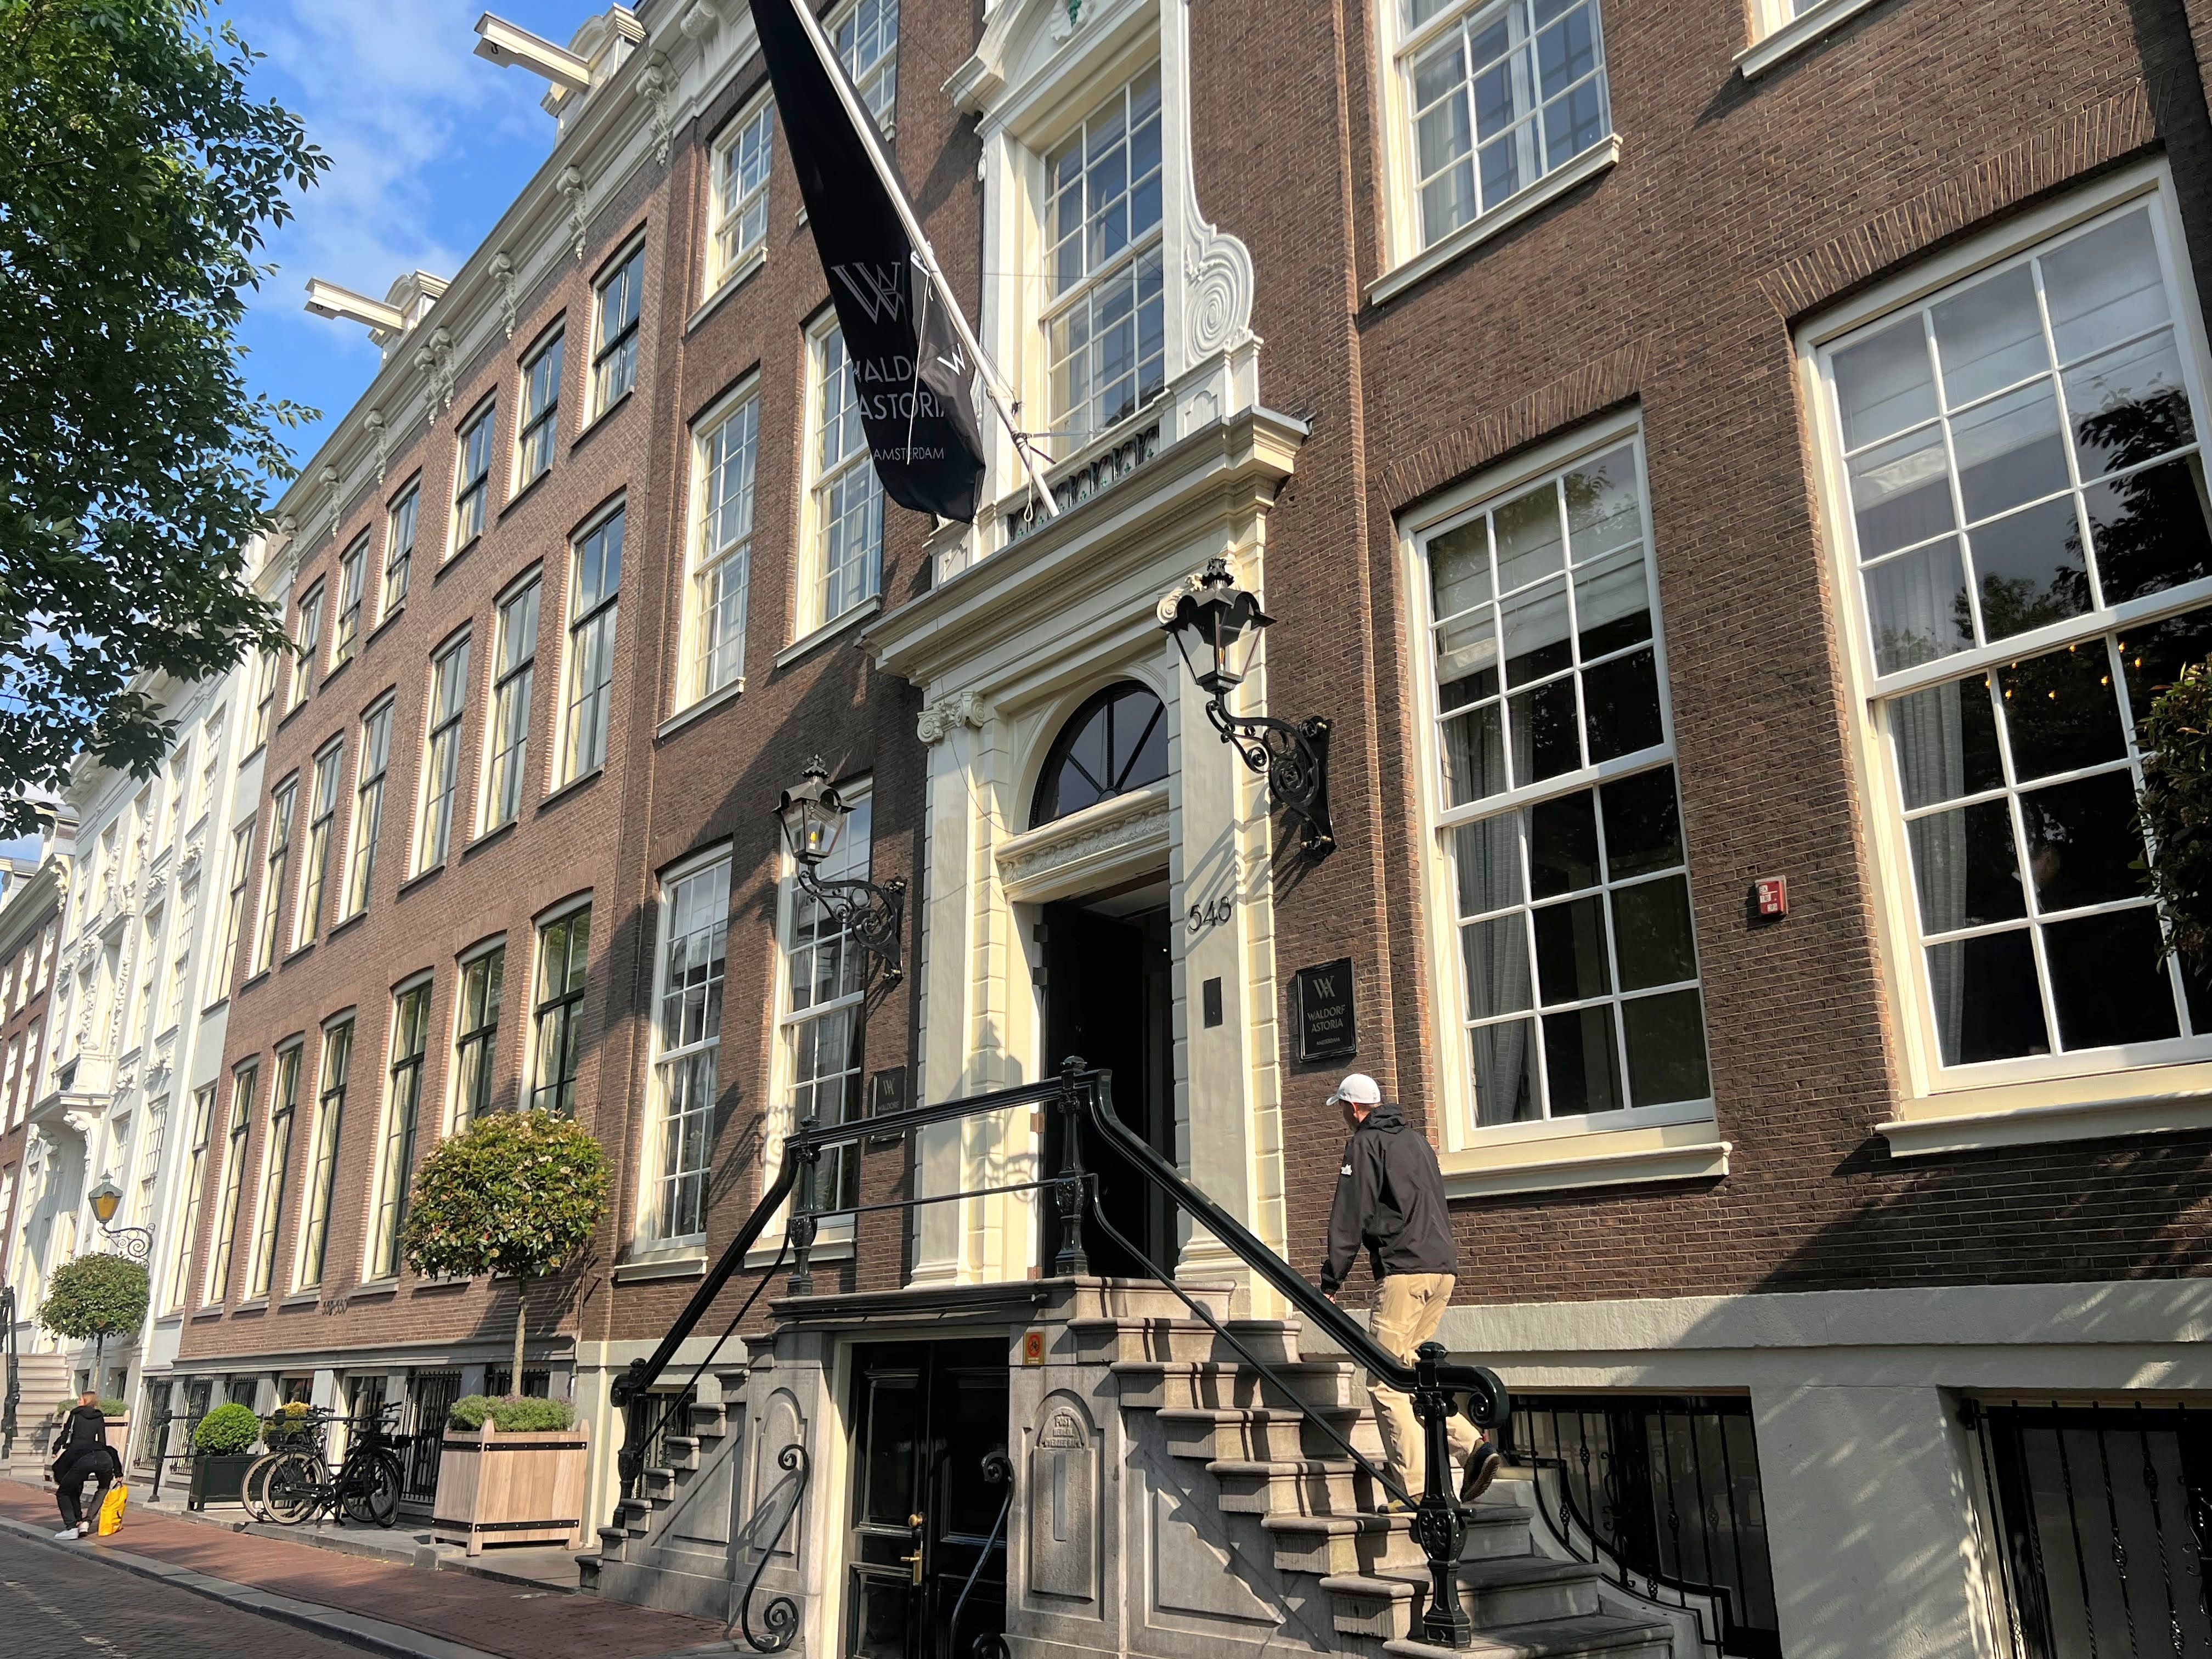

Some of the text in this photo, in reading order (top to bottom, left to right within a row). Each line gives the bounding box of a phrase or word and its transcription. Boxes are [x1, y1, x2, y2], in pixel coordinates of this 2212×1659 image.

[859, 391, 944, 420] ASTORI
[1189, 896, 1231, 932] 548
[1307, 1005, 1346, 1021] WALDORF
[1311, 1018, 1343, 1032] ASTORIA
[1054, 1415, 1071, 1427] POST
